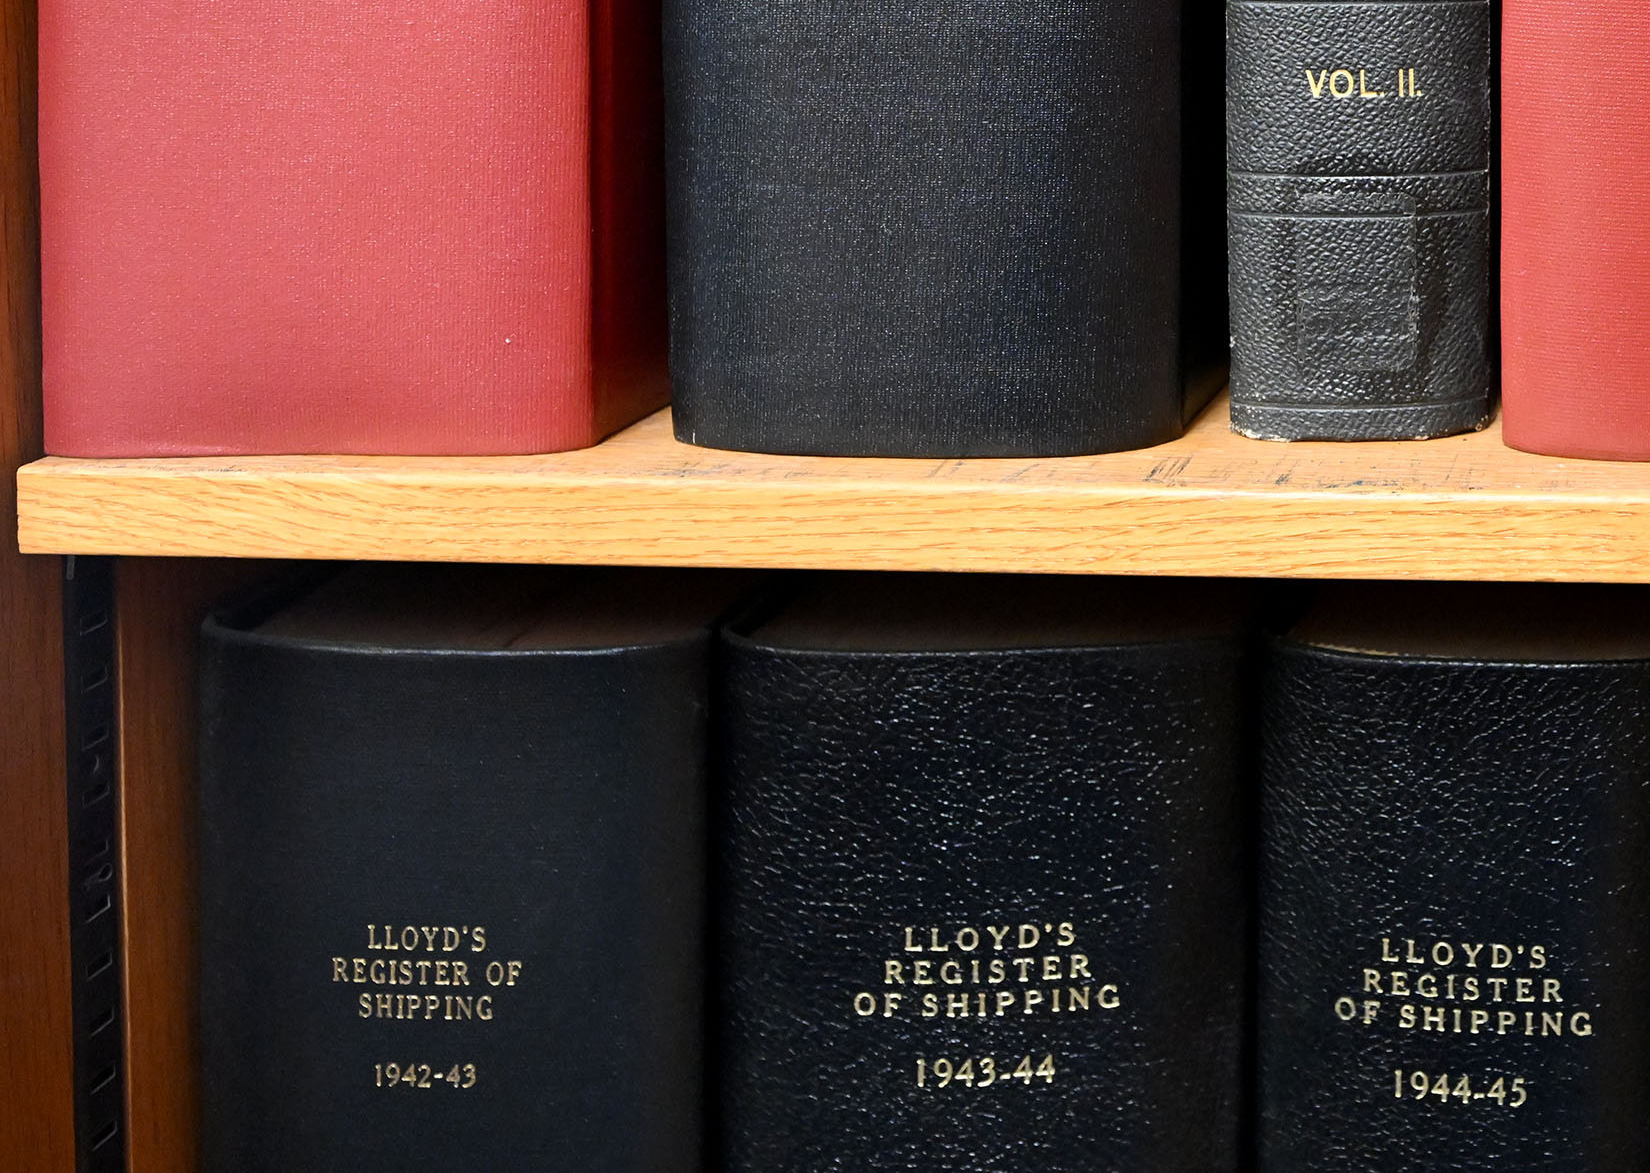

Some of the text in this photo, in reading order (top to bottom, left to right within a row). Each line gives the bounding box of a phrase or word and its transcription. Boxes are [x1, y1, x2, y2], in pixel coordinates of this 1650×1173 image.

[1304, 68, 1423, 99] VOL. II.
[366, 923, 488, 954] LLOYD'S
[904, 921, 1076, 954] LLOYD'S
[1380, 936, 1548, 970] LLOYD'S
[331, 956, 523, 989] REGISTER OF
[883, 954, 1093, 986] REGISTER
[1361, 967, 1565, 1004] REGISTER
[358, 992, 494, 1023] SHIPPING
[852, 984, 1121, 1019] OF SHIPPING
[1333, 996, 1593, 1039] OF SHIPPING
[372, 1061, 478, 1090] 1942-43
[914, 1054, 1057, 1089] 1943-44
[1392, 1069, 1528, 1110] 1944-45
